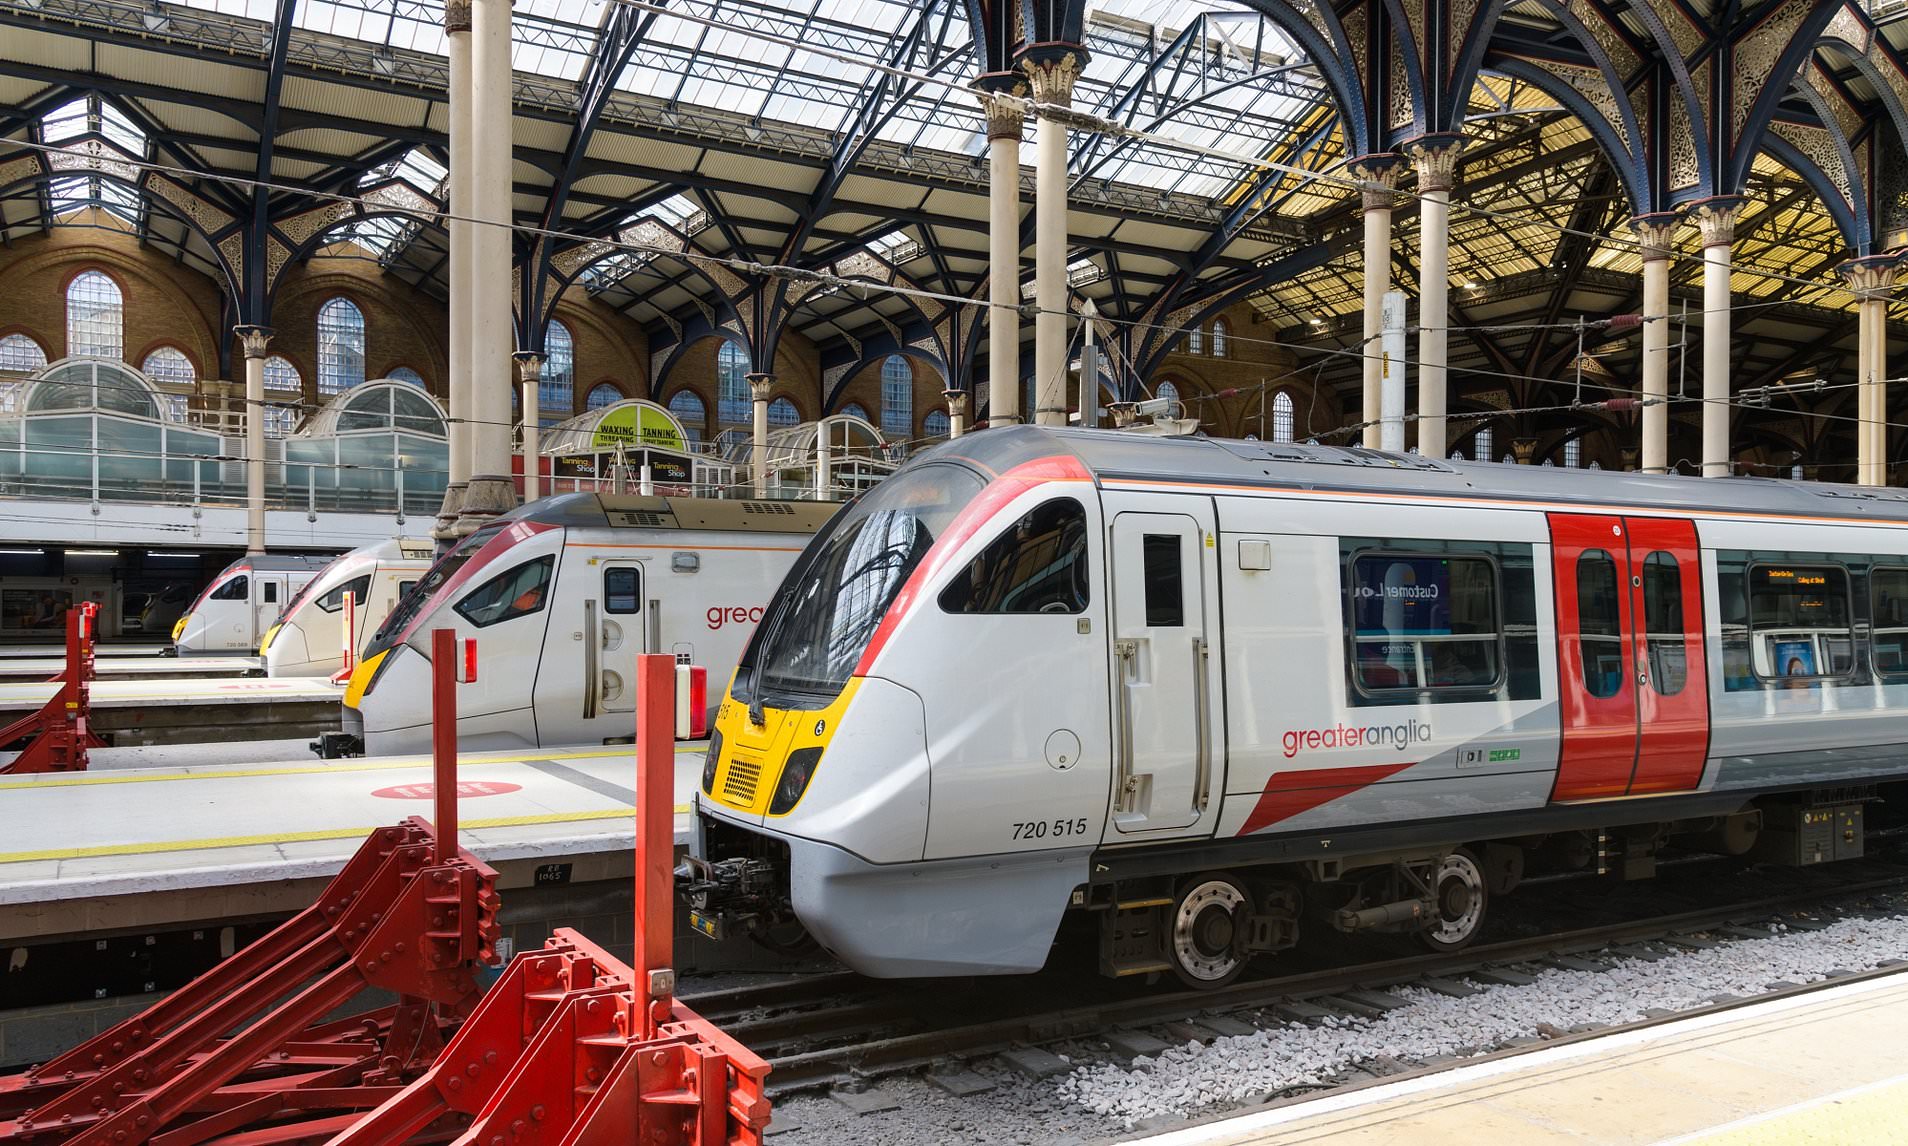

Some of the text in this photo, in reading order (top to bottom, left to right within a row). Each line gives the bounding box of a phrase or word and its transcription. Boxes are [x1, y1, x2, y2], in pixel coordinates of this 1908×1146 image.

[600, 425, 634, 436] WAXING
[643, 427, 676, 439] TANNING
[561, 457, 589, 467] Tanning
[653, 461, 680, 471] Tanning
[576, 464, 595, 474] Shop
[667, 469, 686, 478] Shop
[1282, 718, 1432, 759] greateranglia
[1012, 817, 1088, 840] 720 515
[538, 871, 563, 881] 1065
